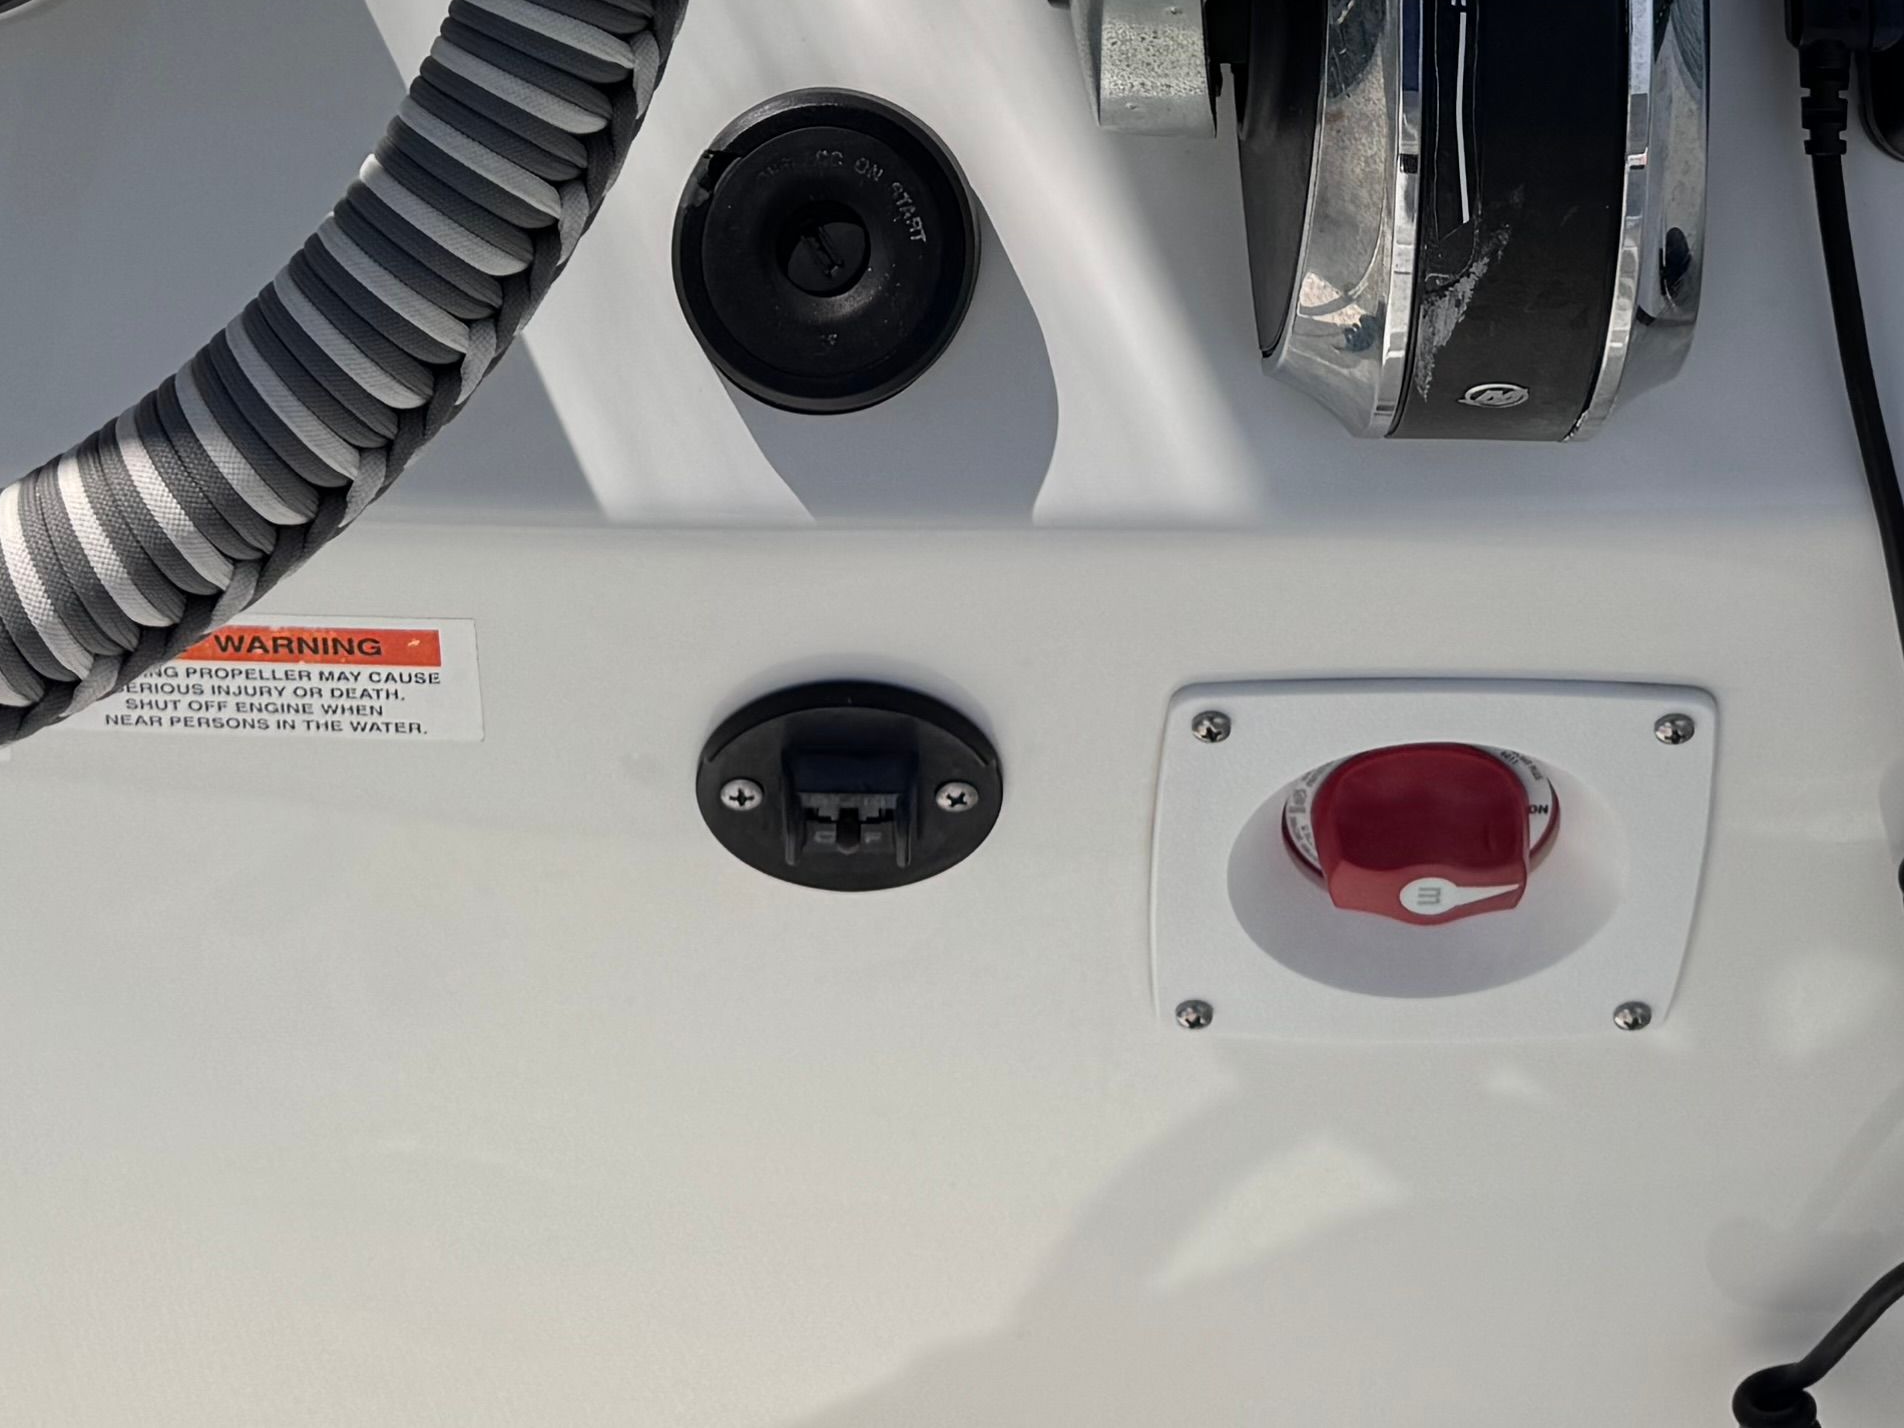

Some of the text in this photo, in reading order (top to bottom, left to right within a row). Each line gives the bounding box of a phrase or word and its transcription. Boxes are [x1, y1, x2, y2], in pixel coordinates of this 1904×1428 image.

[213, 633, 383, 656] WARNING
[185, 666, 312, 682] PROPELLER
[318, 670, 362, 683] MAY
[368, 671, 441, 685] CAUSE
[211, 684, 287, 698] INJURY
[292, 686, 324, 699] OR
[330, 687, 406, 702] DEATH.
[125, 697, 384, 717] SHUT OFF ENGINE WHEN
[105, 714, 429, 736] NEAR PERSONS IN THE WATER.
